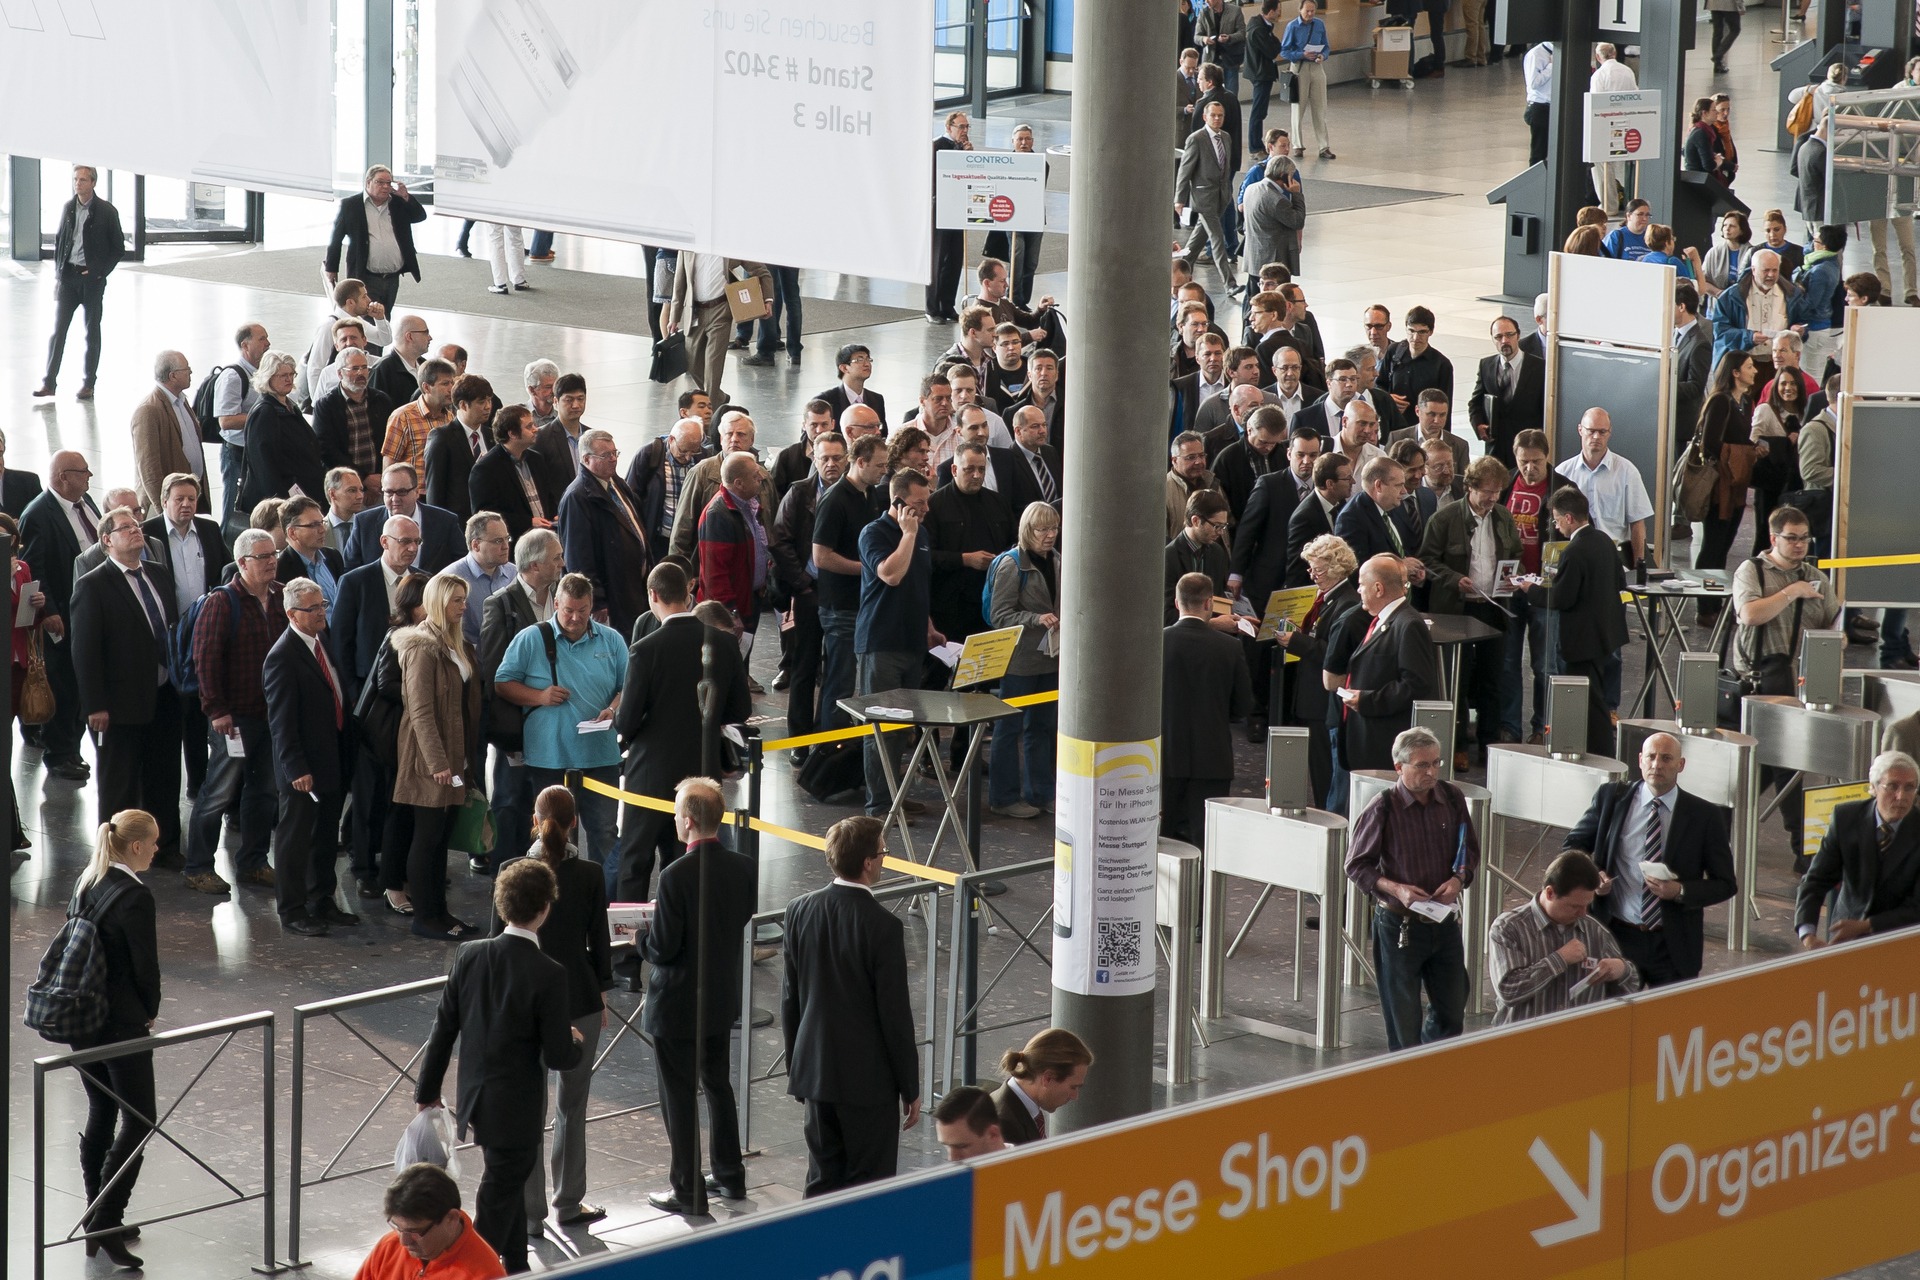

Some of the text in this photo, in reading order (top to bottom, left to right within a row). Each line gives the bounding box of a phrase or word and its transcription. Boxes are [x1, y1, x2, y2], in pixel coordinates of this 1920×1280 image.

[1610, 94, 1642, 102] CONTROL
[966, 155, 1015, 165] CONTROL
[1099, 788, 1115, 797] Die
[1118, 788, 1144, 797] Messe
[1099, 799, 1153, 809] für Ihr iPhone
[1099, 818, 1129, 826] Kostenlos
[1129, 817, 1146, 825] WLAN
[1121, 840, 1148, 849] Stuttgart
[1098, 863, 1148, 872] Eingangsbereich
[1098, 872, 1125, 881] Eingang
[1097, 887, 1113, 895] Ganz
[1110, 895, 1136, 903] loslegen!
[1004, 1132, 1367, 1278] Messe Shop
